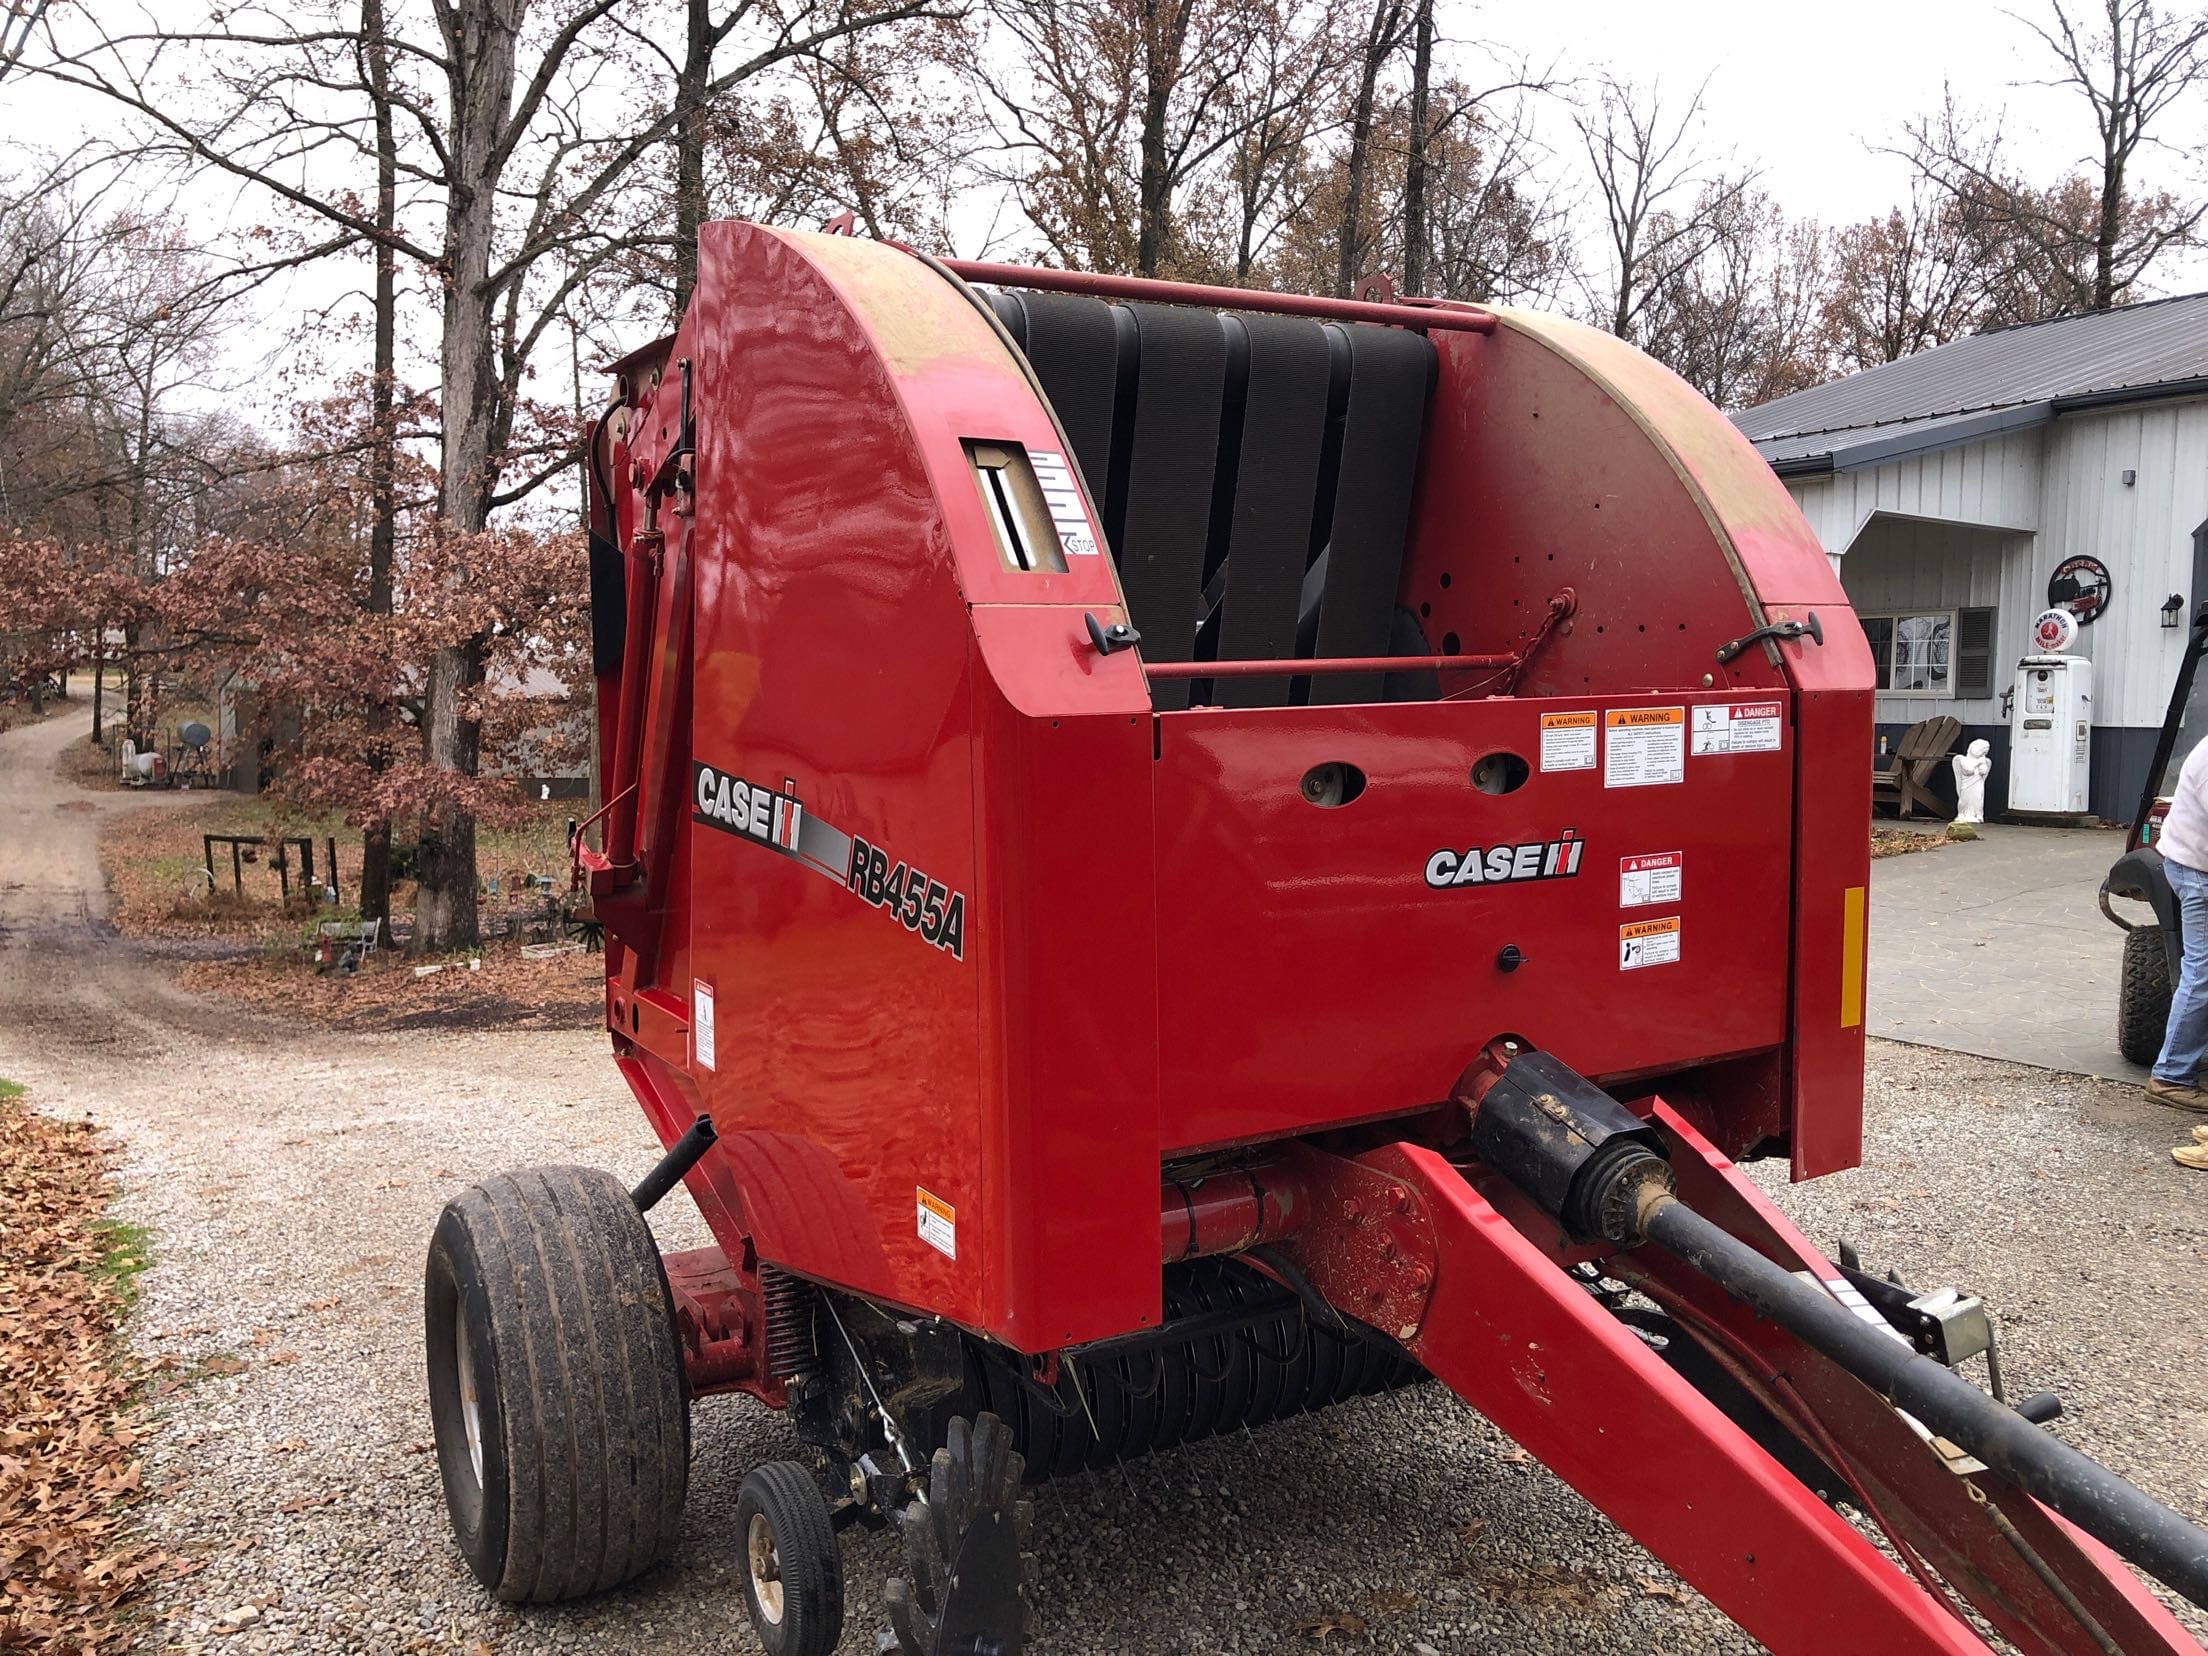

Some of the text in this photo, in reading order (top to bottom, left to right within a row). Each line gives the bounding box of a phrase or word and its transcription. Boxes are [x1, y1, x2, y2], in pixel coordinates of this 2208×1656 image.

[1071, 539, 1095, 553] STOP
[2034, 612, 2068, 629] MARATHON
[1630, 712, 1671, 724] WARNING
[1743, 706, 1777, 718] DANGER
[1555, 716, 1591, 726] WARNING
[1640, 856, 1673, 868] DANGER
[847, 833, 965, 963] RB455A
[1634, 921, 1673, 936] WARNING
[926, 1198, 951, 1219] WARNING
